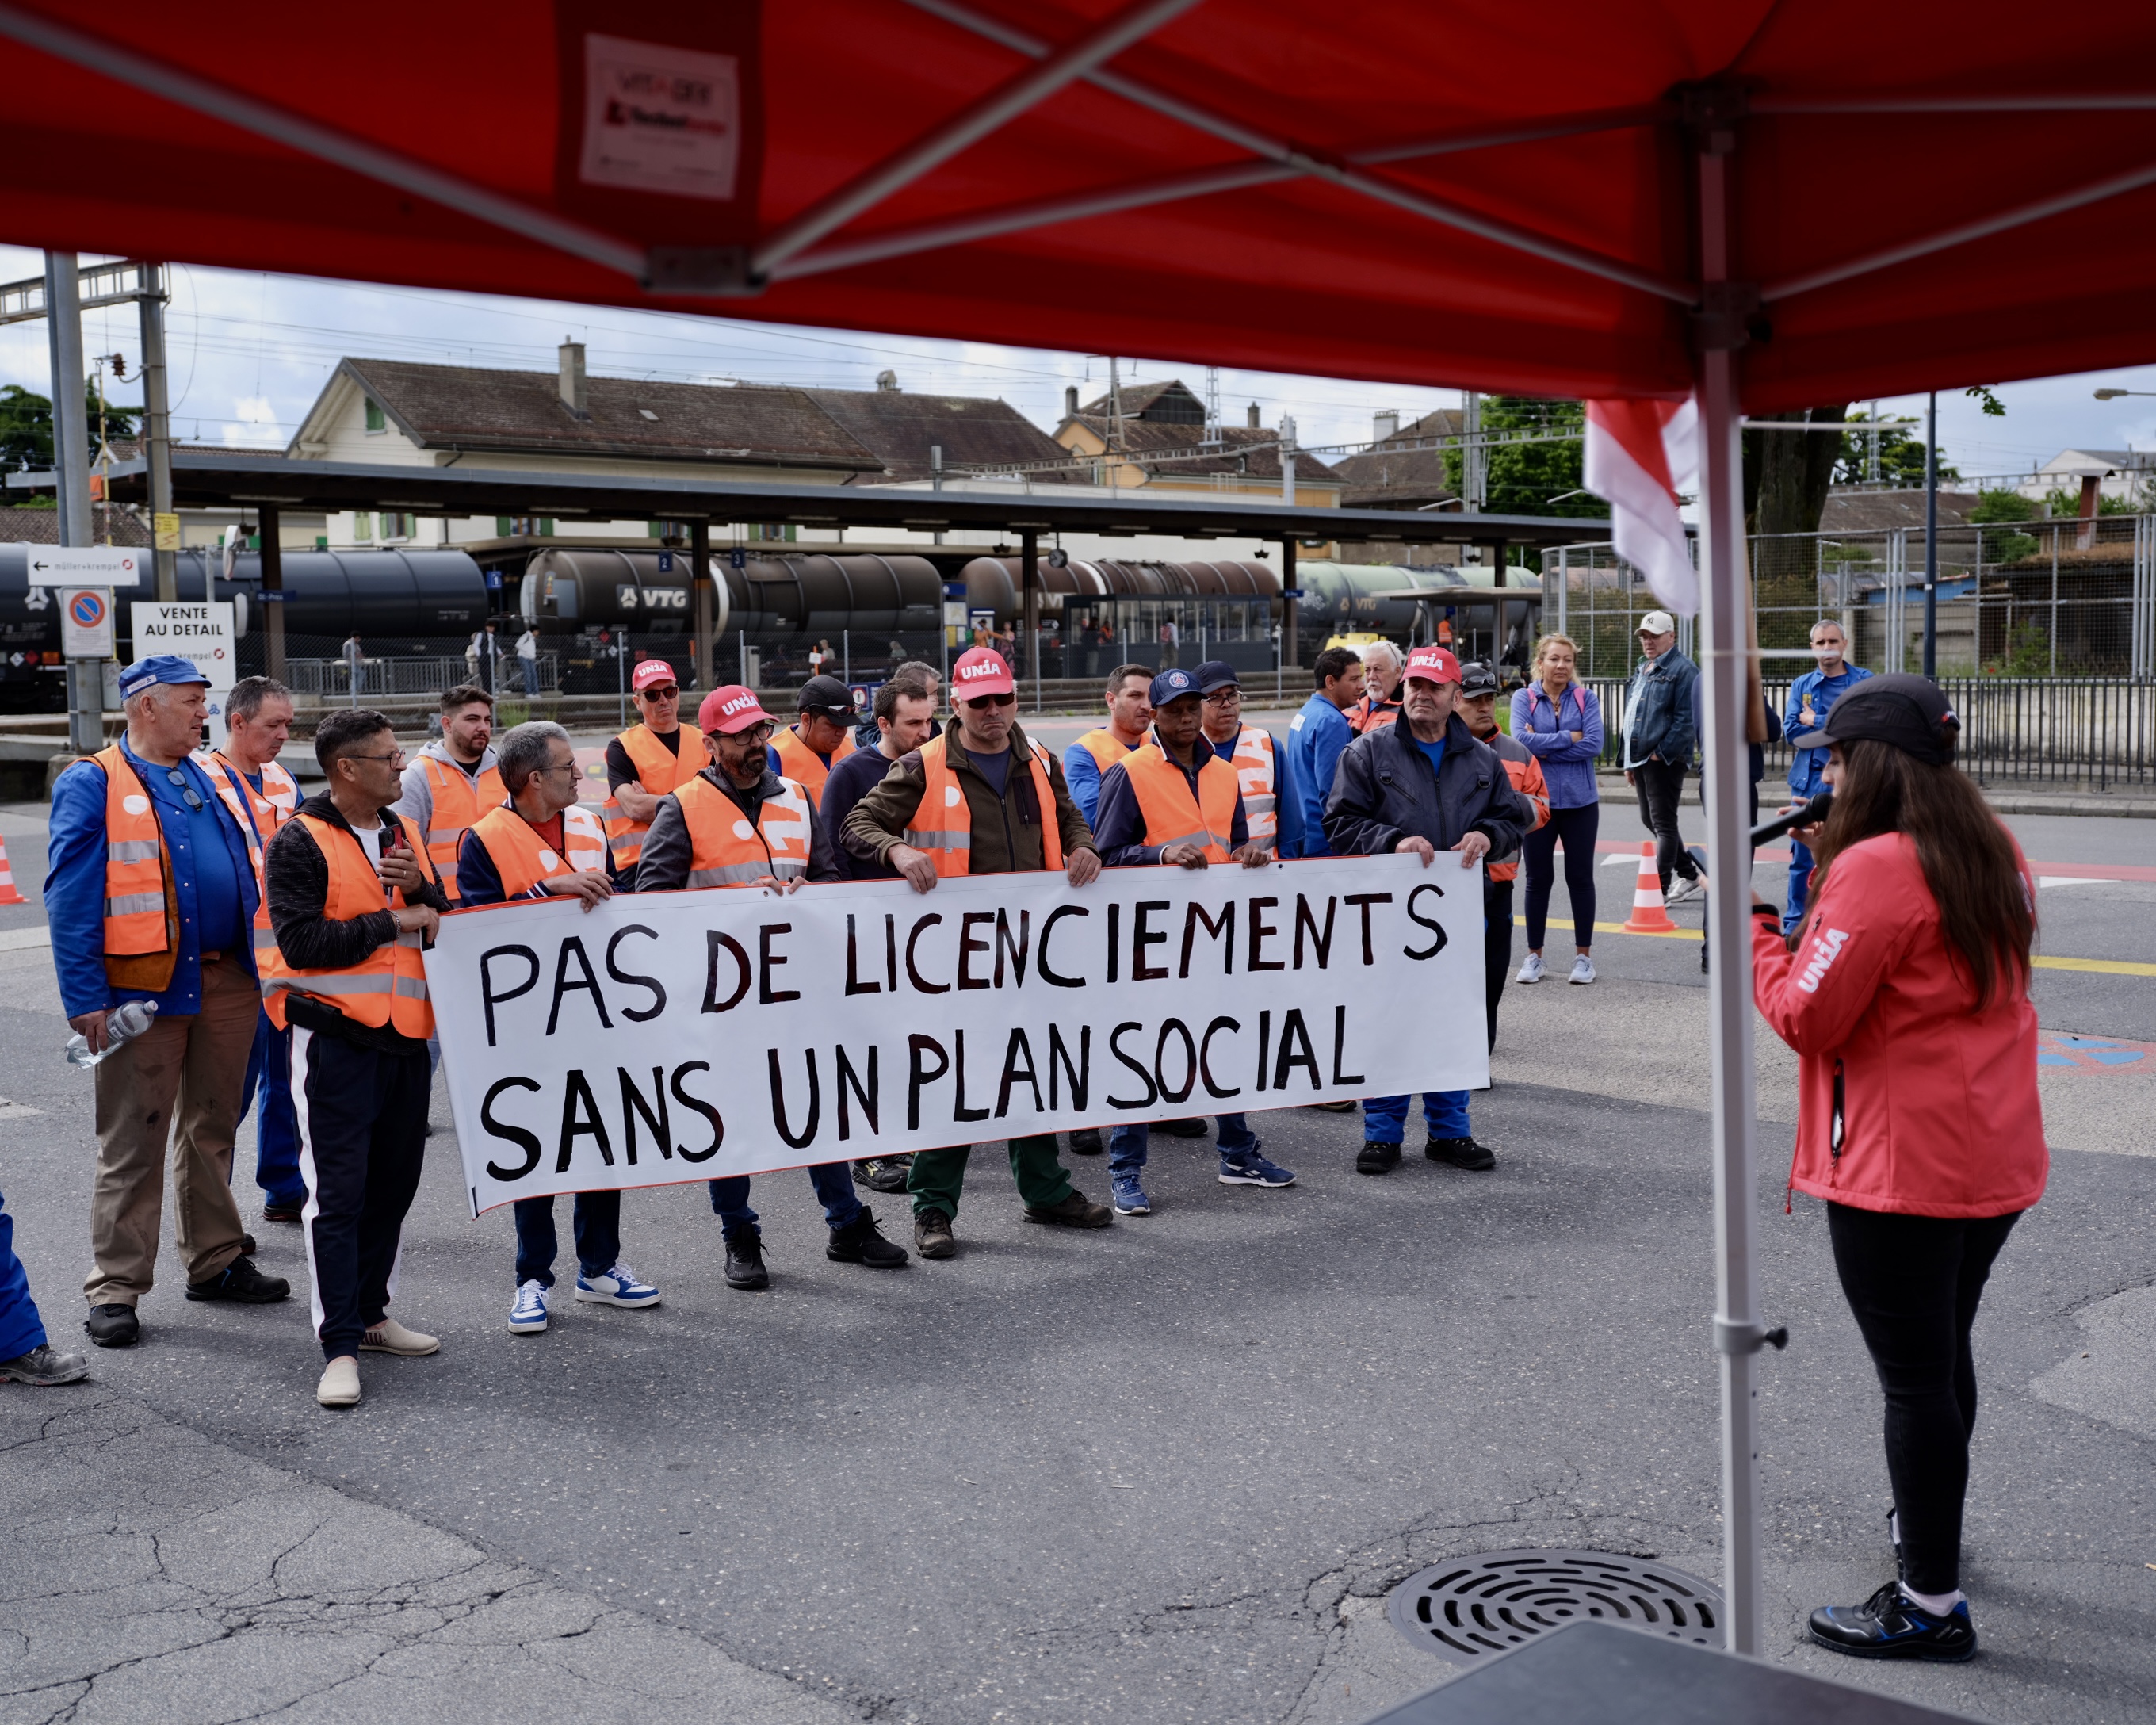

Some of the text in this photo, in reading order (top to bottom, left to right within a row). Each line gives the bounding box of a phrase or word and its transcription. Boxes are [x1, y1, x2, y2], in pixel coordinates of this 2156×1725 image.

[661, 557, 668, 568] 2
[734, 553, 741, 564] 3
[643, 590, 686, 608] VTG
[1355, 597, 1376, 611] VTG
[160, 607, 208, 619] VENTE
[146, 624, 223, 635] AU DETAIL
[480, 883, 1447, 1046] PAS DE LICENCIEMENTS
[480, 1005, 1366, 1182] SANS UN PLAN SOCIAL
